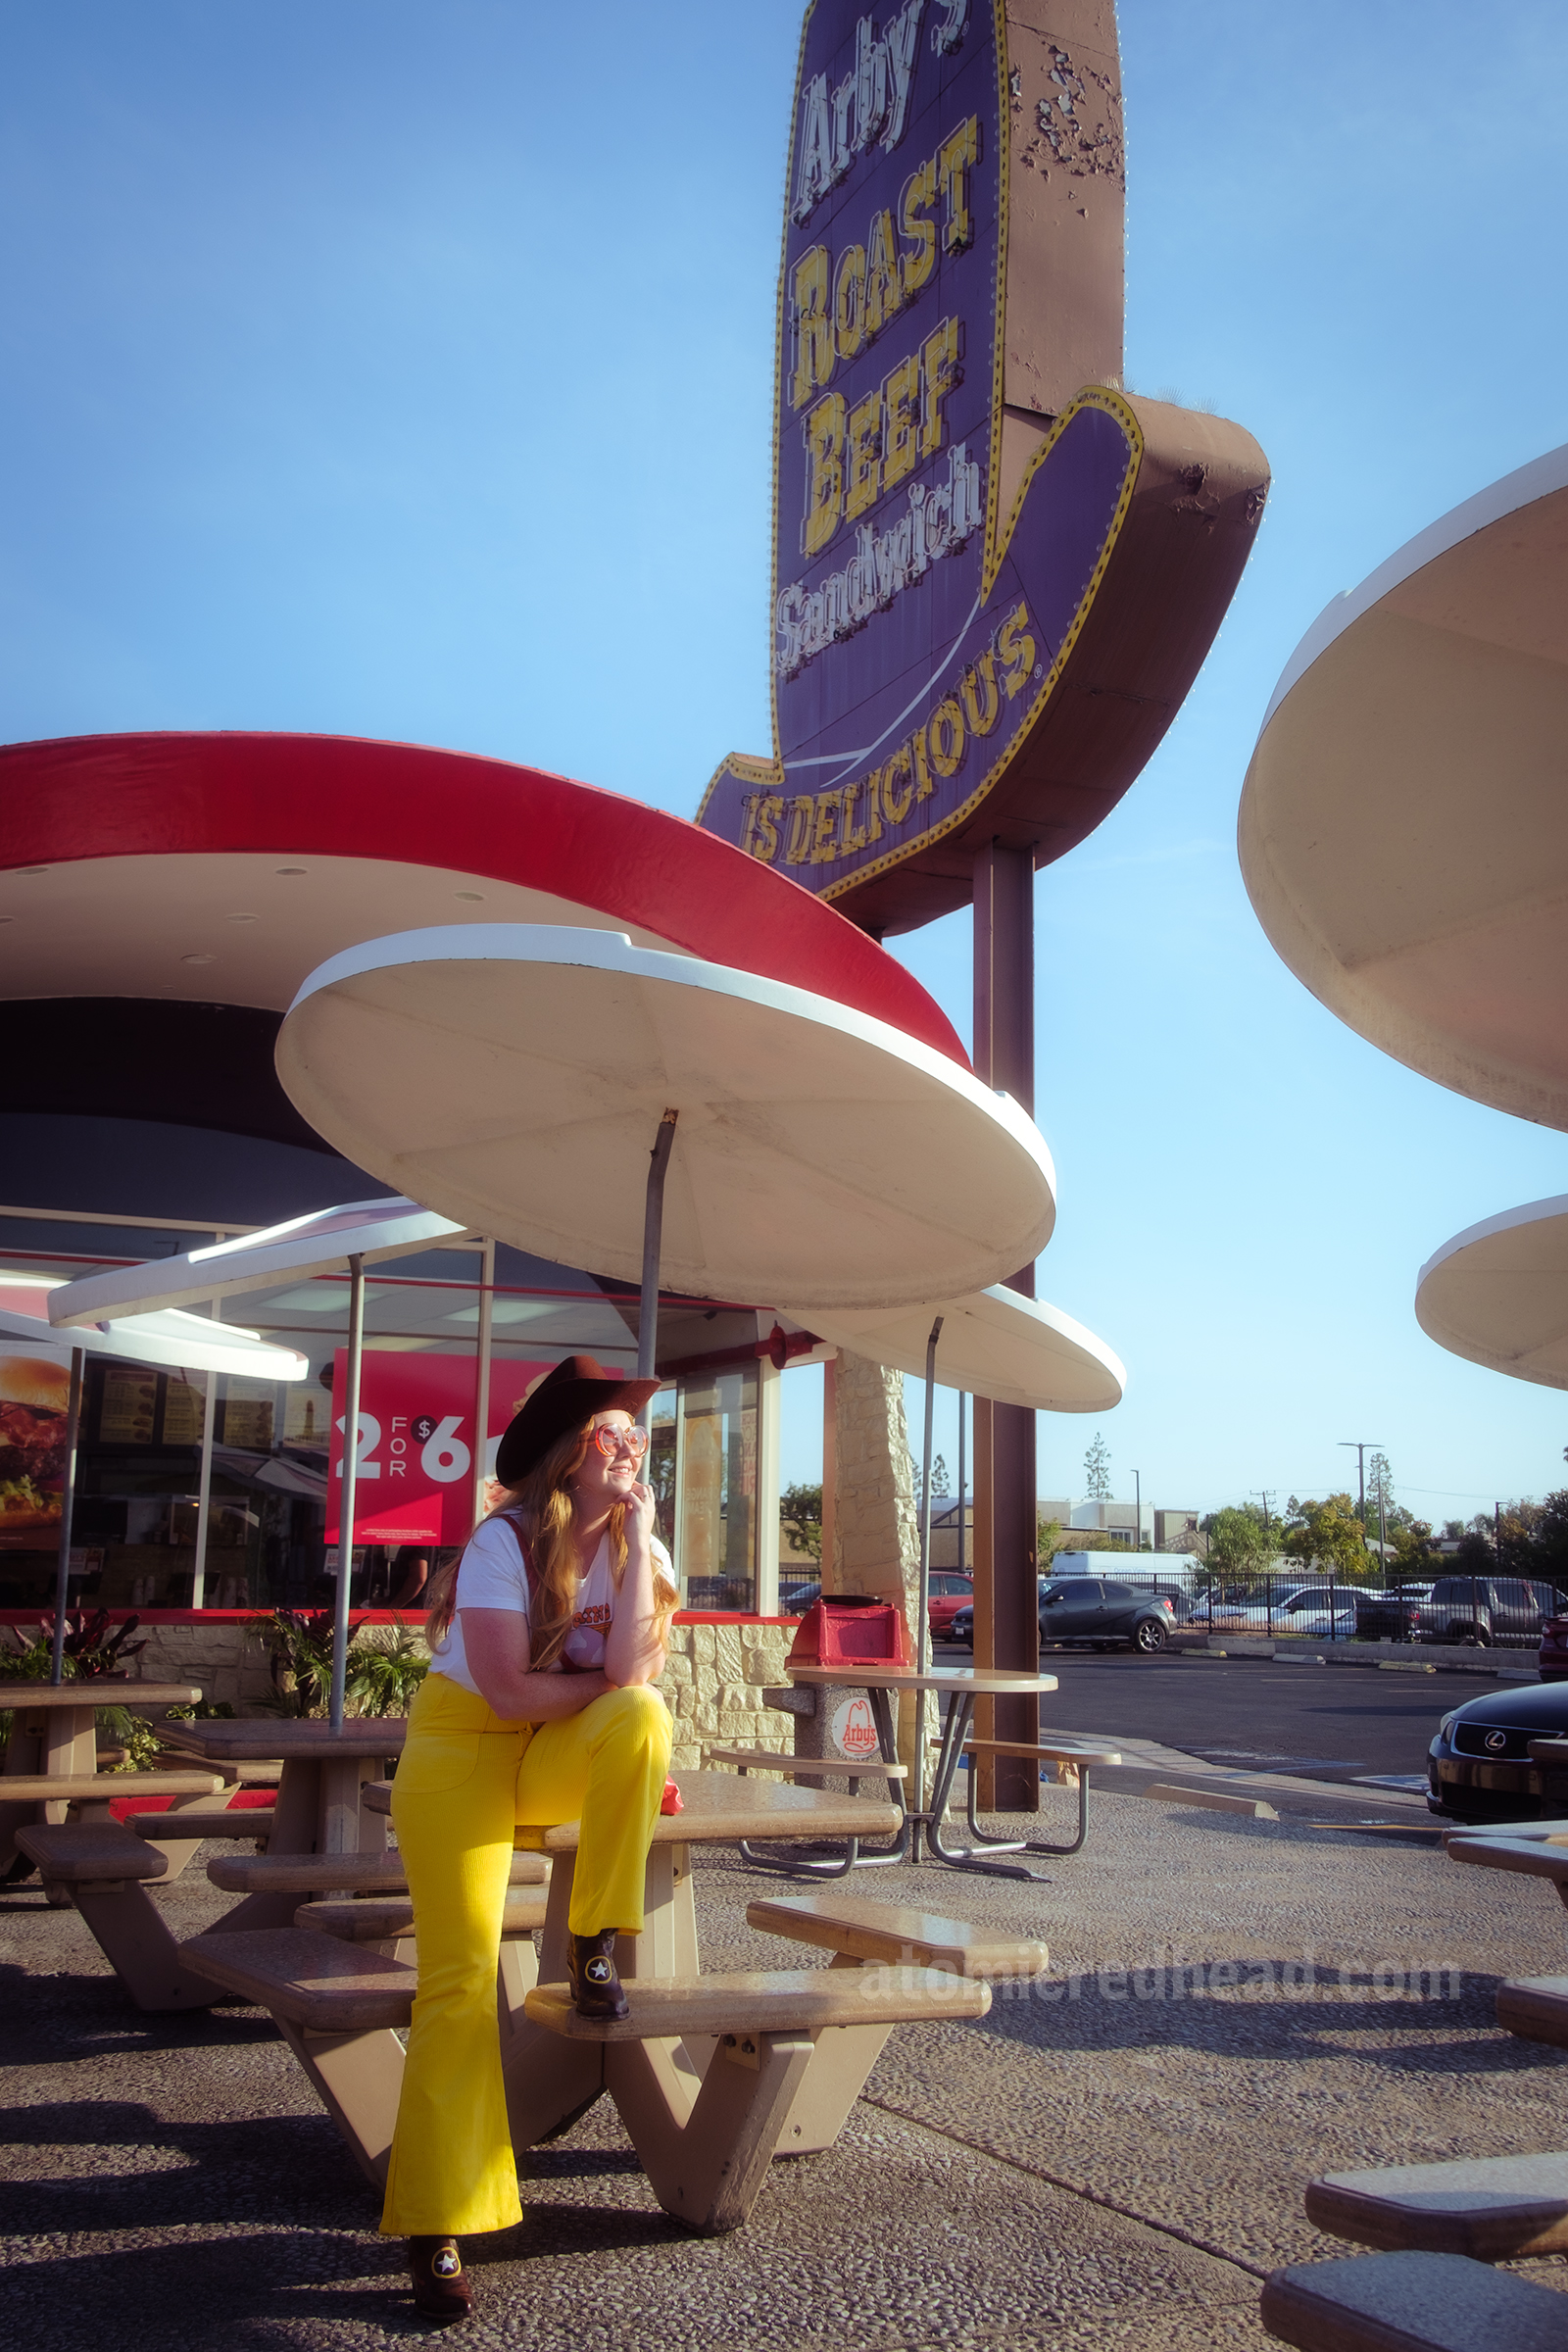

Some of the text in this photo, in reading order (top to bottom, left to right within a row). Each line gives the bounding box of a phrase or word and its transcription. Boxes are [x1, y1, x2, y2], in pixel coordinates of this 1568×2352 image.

[788, 114, 977, 412] ROAST
[801, 315, 958, 558] BEEF
[776, 442, 982, 676] Sandwich
[739, 601, 1035, 864] IS DELICIOUS
[335, 1411, 381, 1479] 2
[389, 1416, 408, 1477] FOR
[843, 1724, 876, 1745] Arby's
